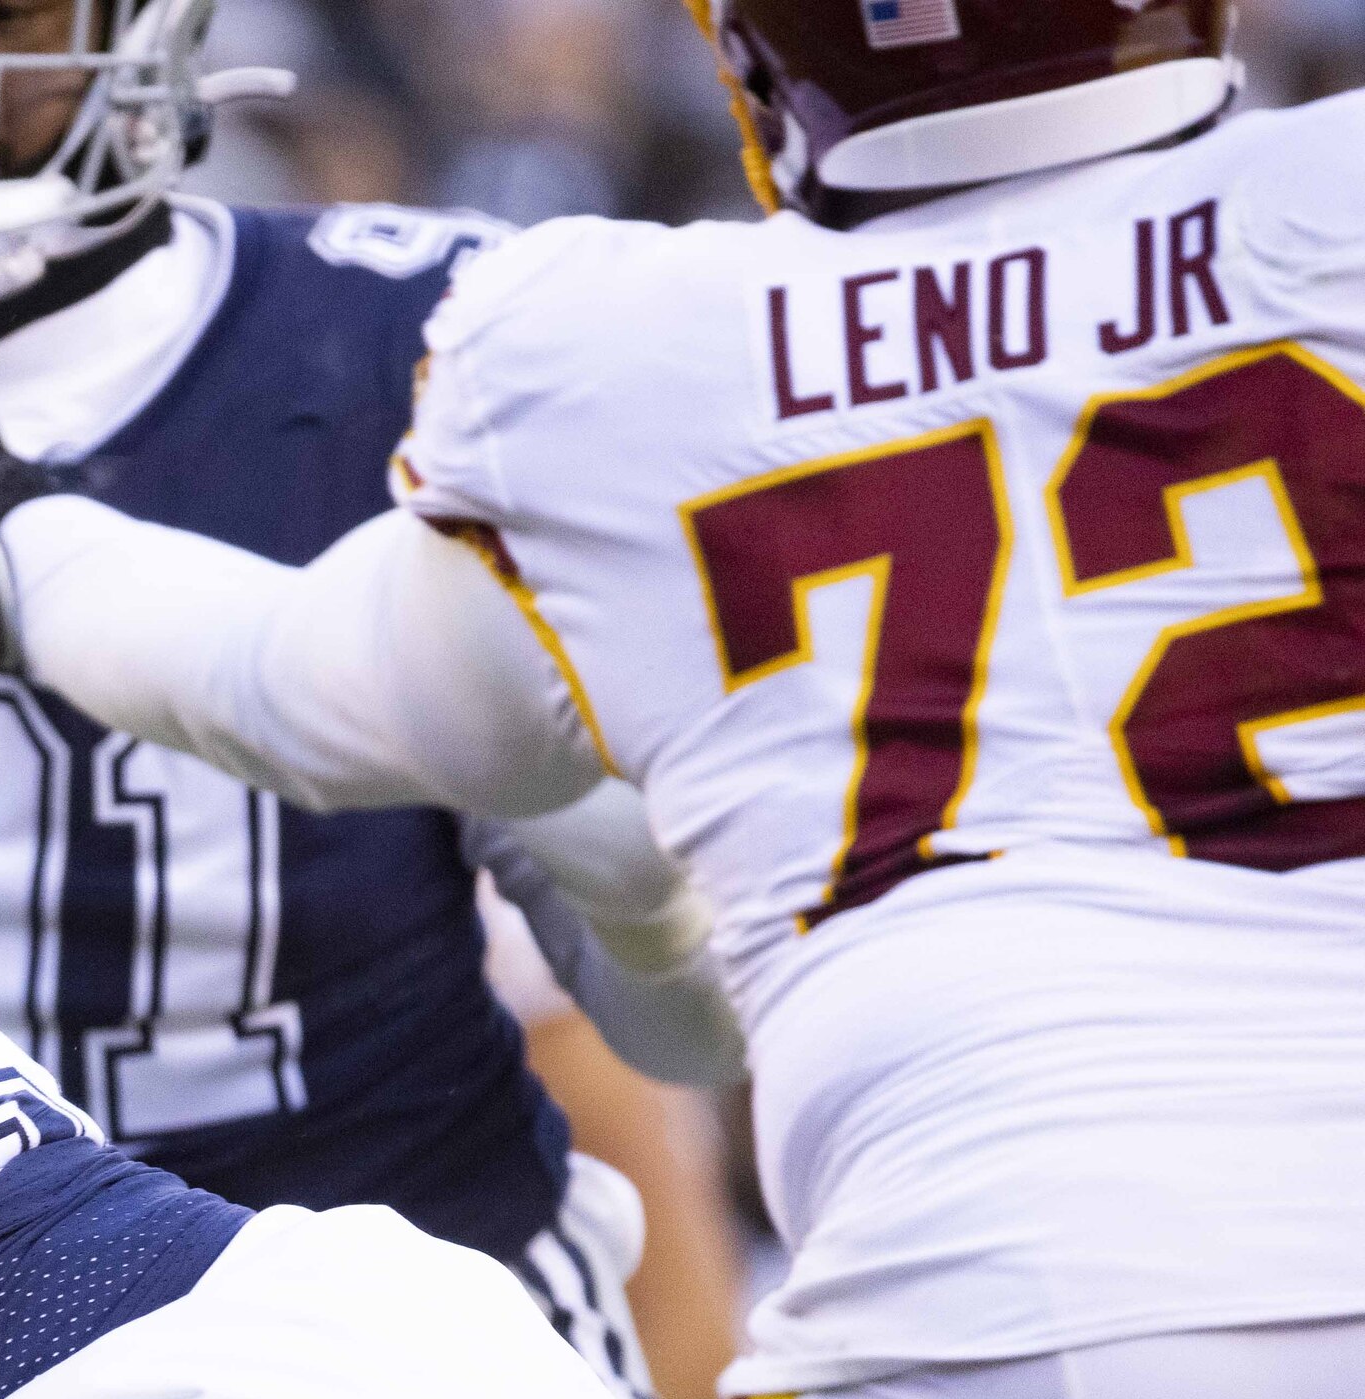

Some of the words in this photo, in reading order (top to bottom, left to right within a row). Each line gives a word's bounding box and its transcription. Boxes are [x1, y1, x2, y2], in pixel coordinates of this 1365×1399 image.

[768, 247, 1048, 421] LENO
[1098, 199, 1232, 355] JR
[678, 340, 1365, 936] 72
